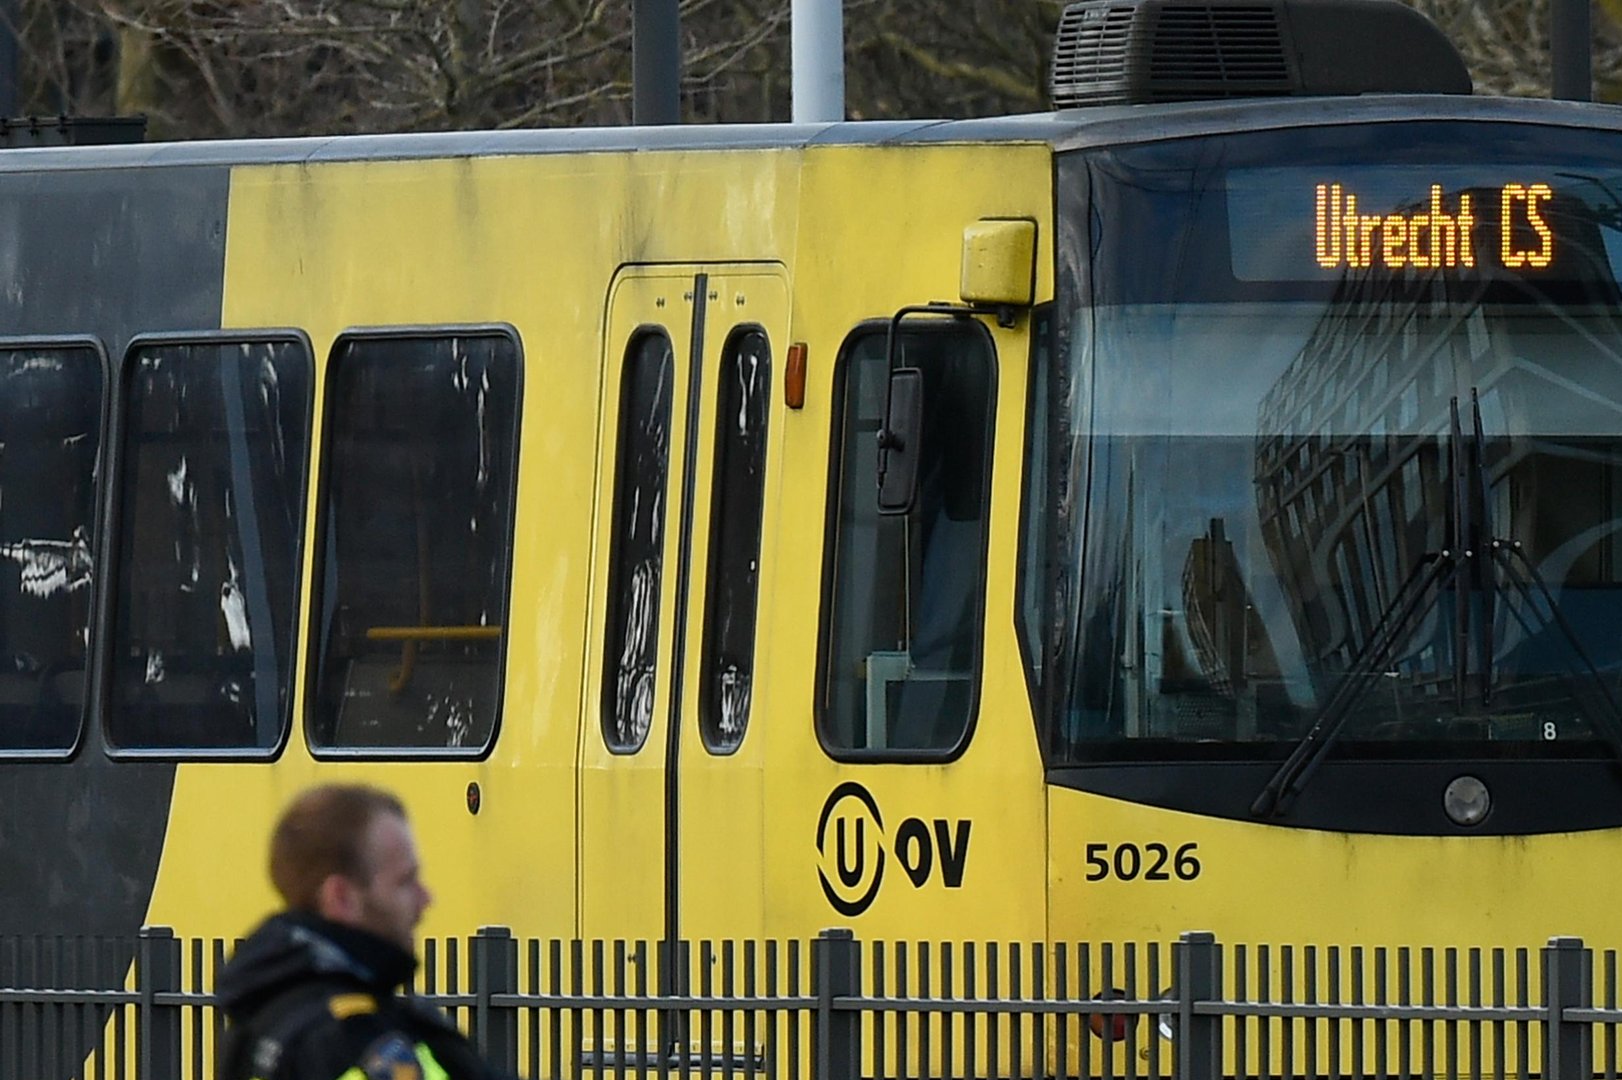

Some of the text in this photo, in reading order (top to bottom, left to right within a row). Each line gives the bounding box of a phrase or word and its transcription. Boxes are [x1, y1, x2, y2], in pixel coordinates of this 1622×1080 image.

[1316, 183, 1553, 268] Utrecht CS
[1543, 721, 1557, 741] 8
[1085, 842, 1201, 882] 5026
